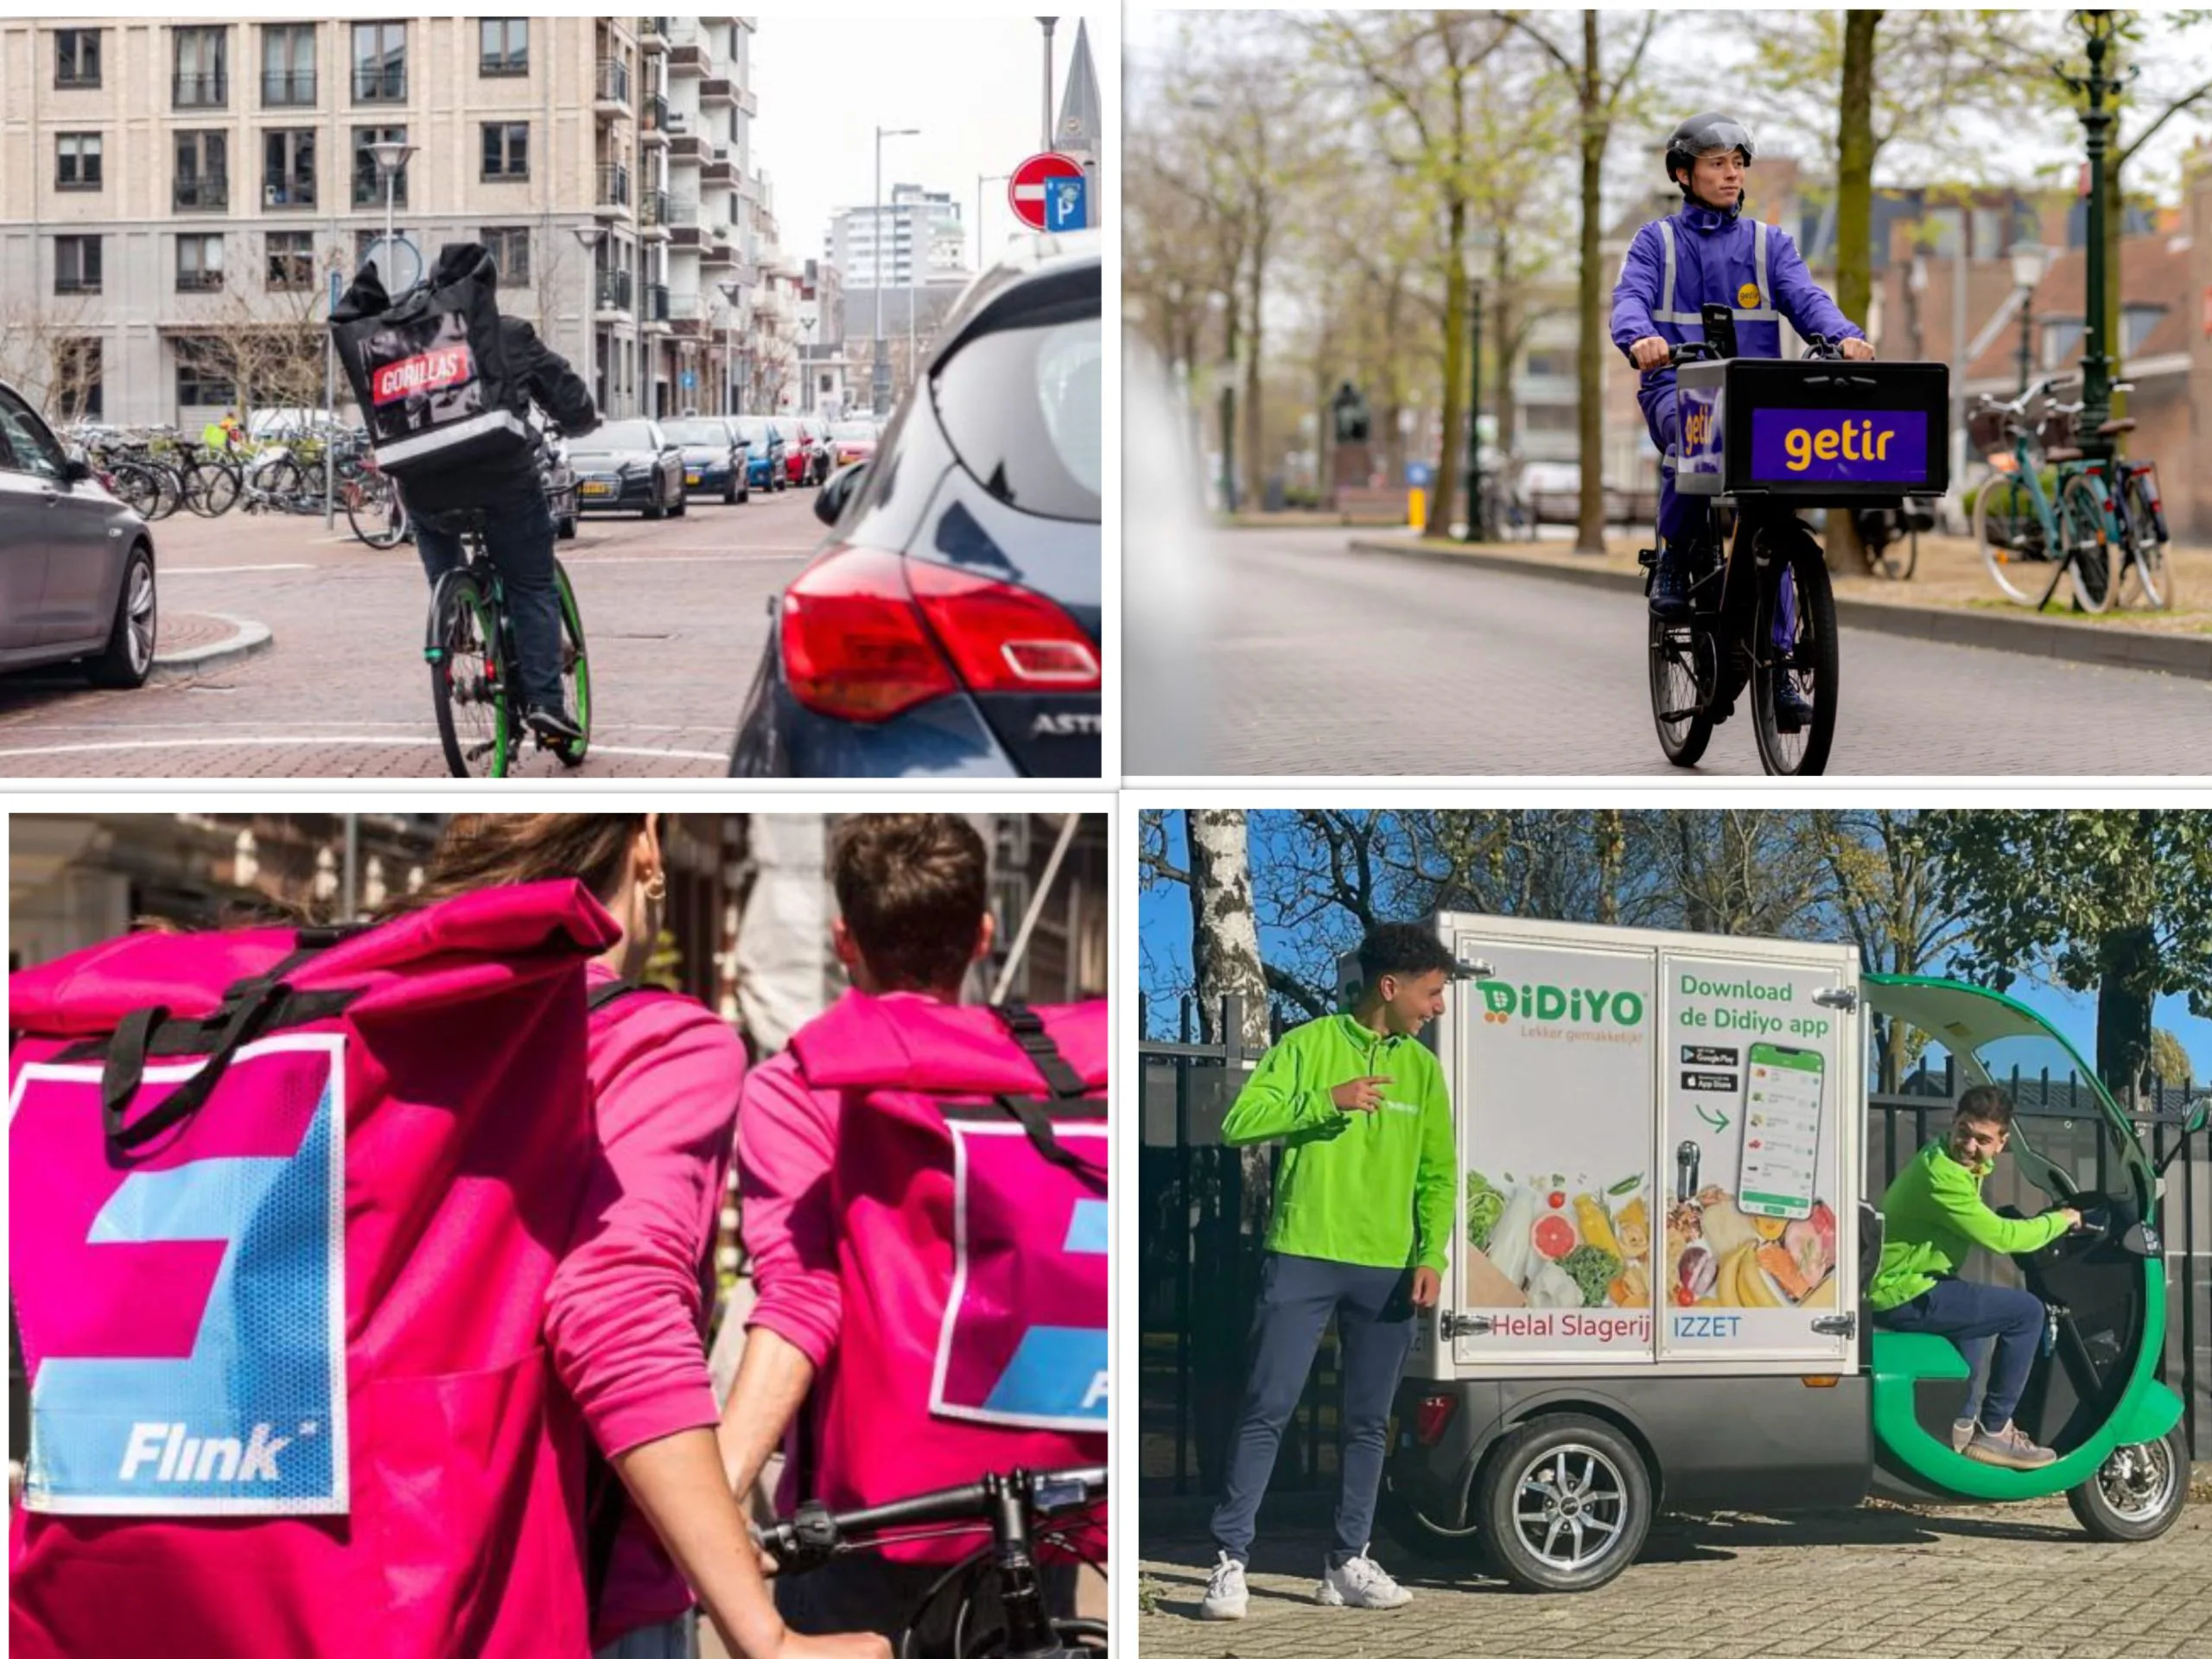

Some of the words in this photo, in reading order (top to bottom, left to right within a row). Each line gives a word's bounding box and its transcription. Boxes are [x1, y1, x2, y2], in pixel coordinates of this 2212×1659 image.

[382, 353, 458, 396] GORILLAS
[1784, 419, 1895, 471] getir
[1681, 974, 1793, 1002] Download
[1521, 1025, 1563, 1039] Lekker
[1680, 1007, 1707, 1027] de
[1714, 1007, 1783, 1035] Didiyo
[1789, 1018, 1828, 1039] app
[1492, 1313, 1554, 1337] Helal
[1561, 1313, 1651, 1342] Slagerij
[1674, 1316, 1741, 1338] IZZET
[118, 1422, 292, 1481] Flink
